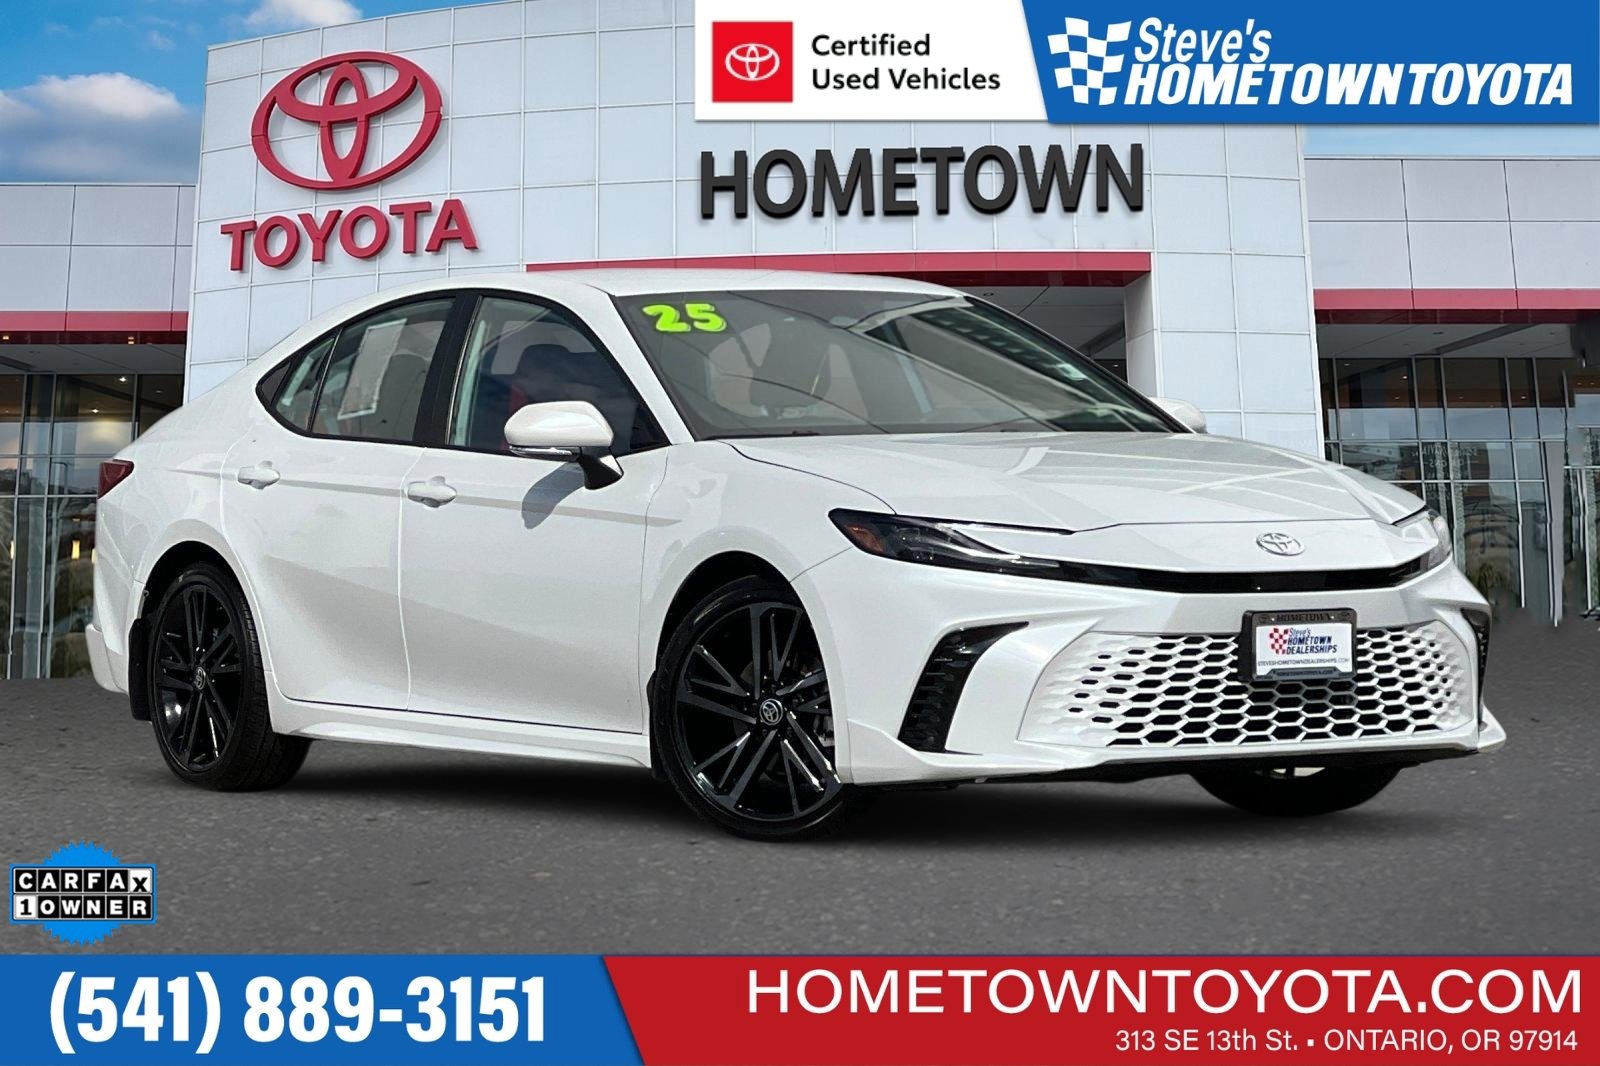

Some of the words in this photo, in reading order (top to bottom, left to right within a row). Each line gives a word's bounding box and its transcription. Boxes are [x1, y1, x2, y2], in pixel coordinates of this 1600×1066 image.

[700, 143, 1145, 220] HOMETOWN
[221, 199, 478, 271] TOYOTA
[643, 302, 727, 333] 25
[1287, 635, 1333, 646] HOMETOWN
[1289, 627, 1311, 638] Steve's
[1286, 644, 1338, 655] DEALERSHIPS
